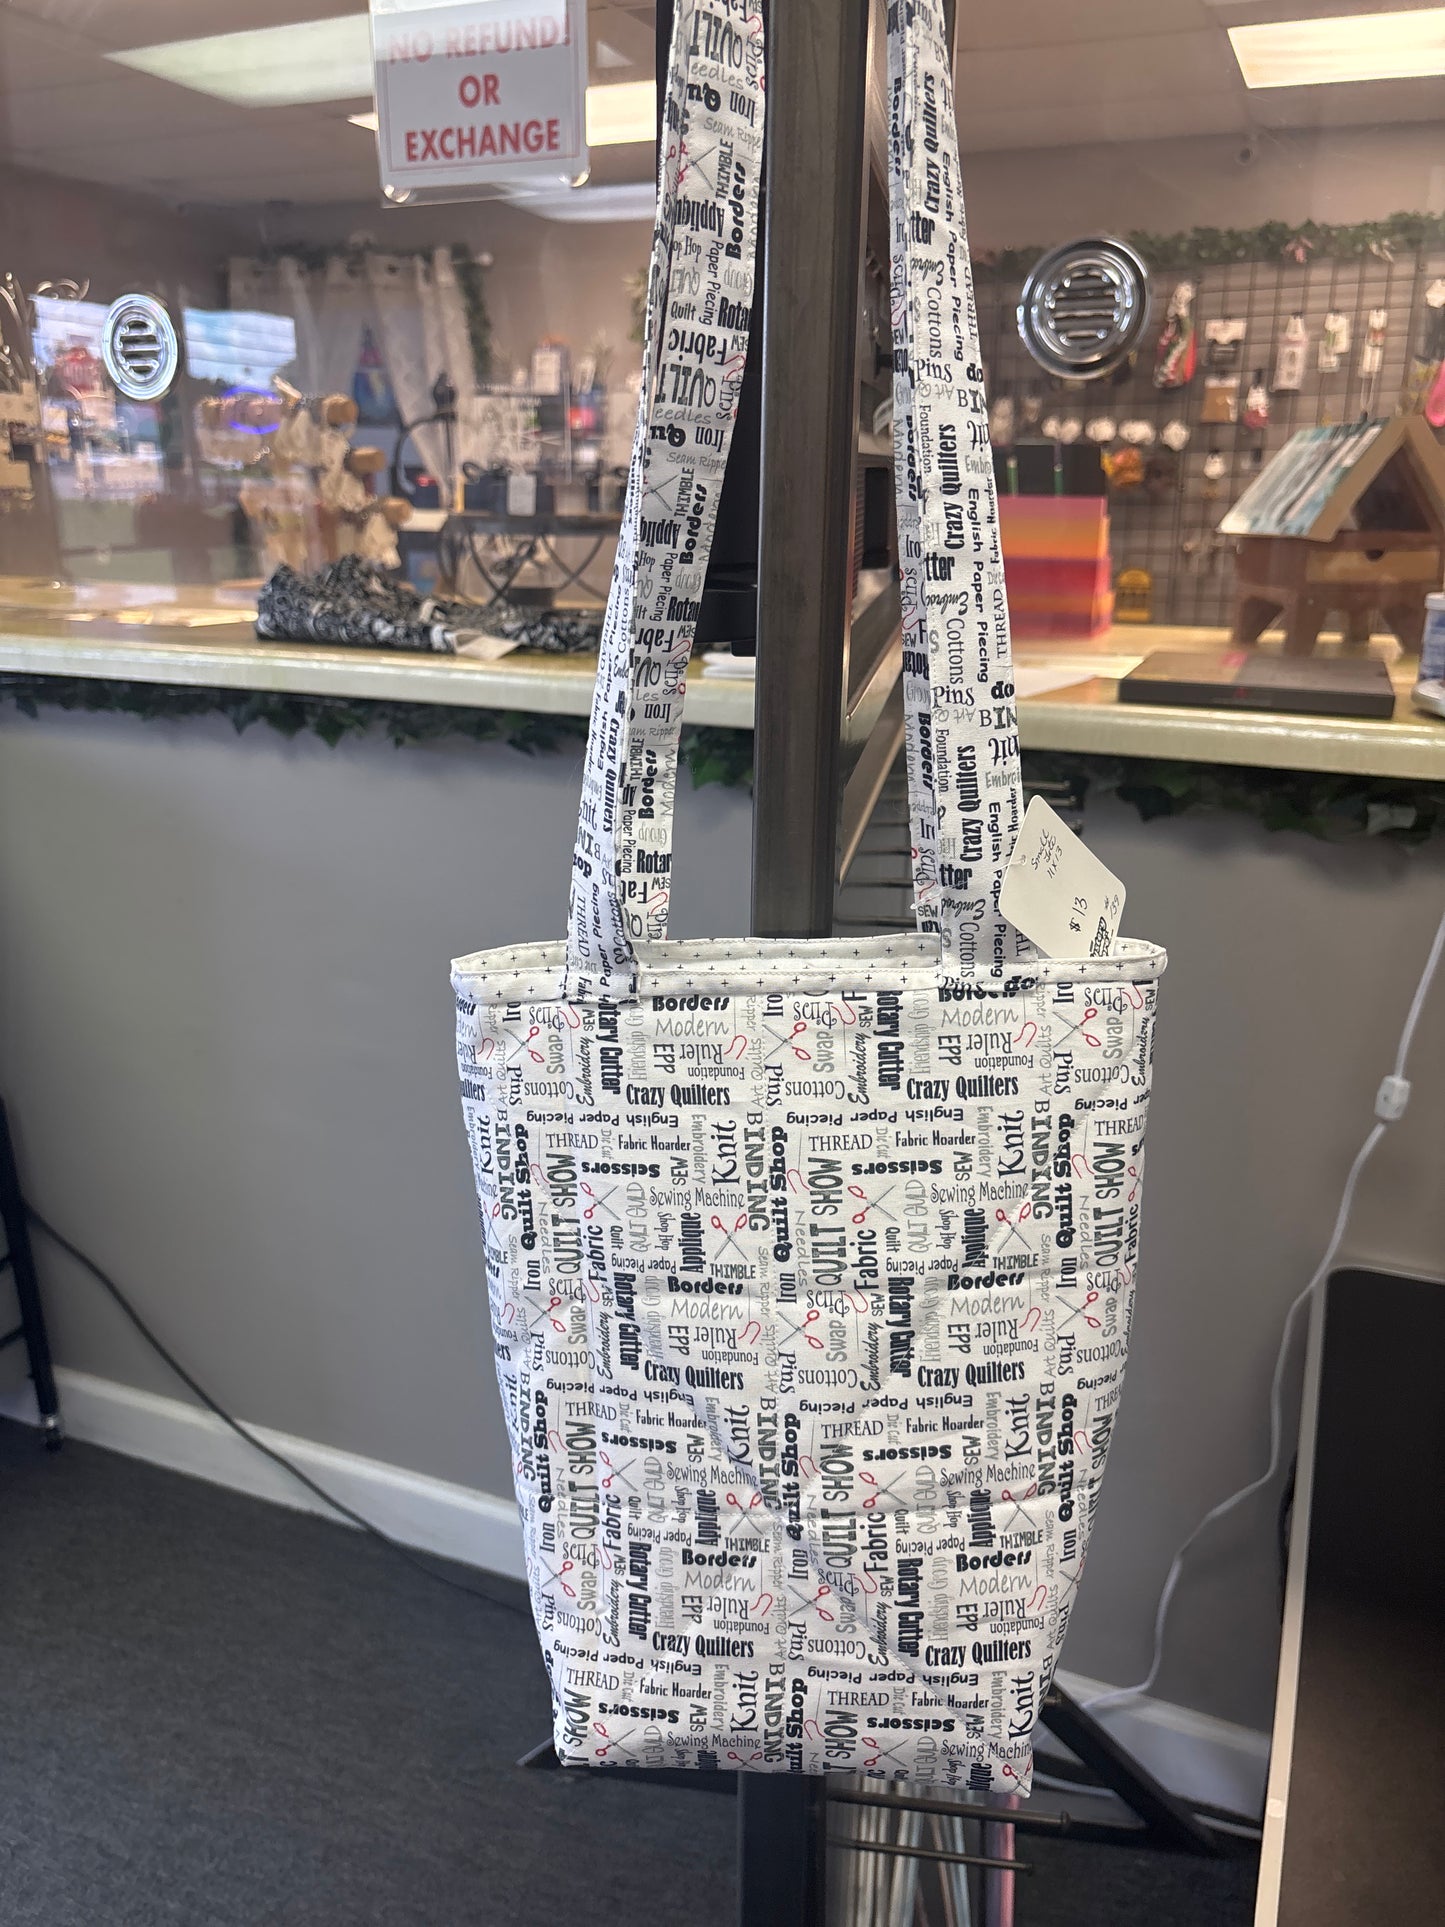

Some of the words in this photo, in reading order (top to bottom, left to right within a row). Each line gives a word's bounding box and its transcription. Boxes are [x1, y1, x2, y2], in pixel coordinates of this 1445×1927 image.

[389, 31, 433, 65] NO
[689, 10, 743, 68] QUILT
[459, 72, 500, 108] OR
[729, 90, 755, 128] Iron
[405, 118, 560, 162] EXCHANGE
[715, 138, 734, 200] THIMBLE
[724, 161, 747, 260] Borders
[684, 236, 701, 263] Hop
[706, 239, 724, 279] Paper
[671, 301, 697, 320] Quilt
[699, 281, 721, 326] Piecing
[947, 230, 957, 287] Paper
[952, 296, 964, 362] Piecing
[718, 297, 749, 331] Rota
[668, 328, 727, 366] Fabric
[915, 358, 953, 383] Pins
[666, 452, 696, 465] Seam
[938, 424, 962, 495] Quilters
[993, 589, 1008, 658] THREAD
[946, 618, 964, 684] Cottons
[931, 686, 975, 709] Pins
[644, 704, 671, 723] Iron
[629, 738, 644, 781] THIMBLE
[638, 750, 658, 819] Borders
[1031, 829, 1050, 870] Small
[959, 922, 980, 977] Cottons
[990, 924, 1007, 977] Piecing
[651, 993, 730, 1013] Borders
[793, 1001, 837, 1029] Pins
[941, 1002, 1019, 1027] Modern
[582, 1009, 595, 1032] SEW
[938, 1035, 961, 1065] EPP
[965, 1032, 1012, 1056] Ruler
[1103, 1017, 1124, 1059] Swap
[547, 1035, 565, 1075] Swap
[626, 1030, 647, 1082] Friendship
[653, 1043, 676, 1074] EPP
[678, 1043, 723, 1065] Ruler
[974, 1055, 1034, 1071] Foundation
[507, 1064, 524, 1106] Pins
[687, 1066, 745, 1080] Foundation
[764, 1063, 784, 1107] Pins
[906, 1077, 950, 1101] Crazy
[956, 1074, 1019, 1100] Quilters
[524, 1081, 575, 1100] Cottons
[626, 1084, 666, 1106] Crazy
[670, 1083, 730, 1106] Quilters
[785, 1080, 845, 1099] Cottons
[545, 1133, 599, 1149] THREAD
[808, 1134, 873, 1152] THREAD
[876, 1127, 888, 1142] Die
[895, 1130, 929, 1147] Fabric
[933, 1129, 976, 1146] Hoarder
[494, 1108, 517, 1221] BINDING
[877, 1145, 891, 1158] Cut
[953, 1150, 973, 1181] SEW
[548, 1152, 578, 1207] SHOW
[582, 1162, 661, 1178] Scissors
[670, 1156, 689, 1186] SEW
[744, 1110, 770, 1231] BINDING
[1092, 1141, 1126, 1200] SHOW
[650, 1186, 692, 1211] Sewing
[694, 1189, 745, 1209] Machine
[807, 1156, 843, 1216] SHOW
[931, 1182, 975, 1207] Sewing
[979, 1181, 1029, 1201] Machine
[939, 1209, 957, 1231] Shop
[1078, 1196, 1095, 1269] Needles
[508, 1234, 517, 1265] Seam
[551, 1214, 585, 1274] QUILT
[678, 1212, 705, 1274] Applique
[885, 1226, 901, 1253] Quilt
[936, 1232, 955, 1249] Hop
[1041, 1234, 1050, 1265] Seam
[1093, 1207, 1124, 1267] QUILT
[810, 1223, 847, 1286] QUILT
[850, 1229, 879, 1290] Fabric
[886, 1258, 924, 1275] Piecing
[928, 1256, 958, 1272] Paper
[992, 1253, 1039, 1270] THIMBLE
[508, 1267, 519, 1301] Ripper
[667, 1275, 744, 1295] Borders
[948, 1272, 1025, 1290] Borders
[1035, 1268, 1049, 1304] Ripper
[1056, 1257, 1077, 1289] Iron
[1087, 1271, 1121, 1293] Pins
[549, 1277, 585, 1303] Pins
[951, 1291, 1024, 1316] Modern
[568, 1306, 587, 1345] Swap
[667, 1326, 689, 1355] EPP
[974, 1319, 1018, 1343] Ruler
[530, 1330, 545, 1371] Pins
[826, 1320, 847, 1363] Swap
[983, 1339, 1039, 1355] Foundation
[1056, 1331, 1076, 1376] Pins
[546, 1350, 596, 1369] Cottons
[859, 1322, 884, 1392] Embroidery
[644, 1360, 680, 1385] Crazy
[685, 1365, 744, 1390] Quilters
[918, 1365, 959, 1388] Crazy
[965, 1362, 1025, 1386] Quilters
[565, 1401, 617, 1421] THREAD
[800, 1400, 855, 1413] Piecing
[862, 1395, 908, 1410] Paper
[916, 1393, 973, 1409] English
[520, 1372, 536, 1481] BINDING
[636, 1409, 665, 1427] Fabric
[668, 1412, 706, 1428] Hoarder
[906, 1416, 938, 1433] Fabric
[942, 1414, 984, 1430] Hoarder
[1057, 1393, 1078, 1456] Shop
[566, 1420, 596, 1475] SHOW
[601, 1431, 677, 1454] Scissors
[724, 1405, 753, 1467] Knit
[757, 1396, 783, 1510] BINDING
[863, 1445, 952, 1461] Scissors
[672, 1486, 689, 1505] Shop
[1058, 1460, 1076, 1522] Quilt
[568, 1481, 600, 1540] QUILT
[602, 1494, 621, 1550] Fabric
[672, 1509, 690, 1524] Hop
[694, 1489, 721, 1546] Applique
[540, 1522, 555, 1554] Iron
[956, 1550, 1032, 1572] Borders
[895, 1556, 923, 1607] Rotary
[681, 1595, 703, 1624] EPP
[984, 1597, 1026, 1621] Ruler
[898, 1611, 924, 1658] Cutter
[925, 1644, 966, 1667] Crazy
[972, 1640, 1032, 1665] Quilters
[566, 1667, 620, 1691] THREAD
[598, 1703, 679, 1723] Scissors
[730, 1670, 758, 1734] Knit
[828, 1691, 890, 1706] THREAD
[1008, 1671, 1035, 1741] Knit
[941, 1739, 984, 1763] Sewing
[987, 1742, 1032, 1759] Machin
